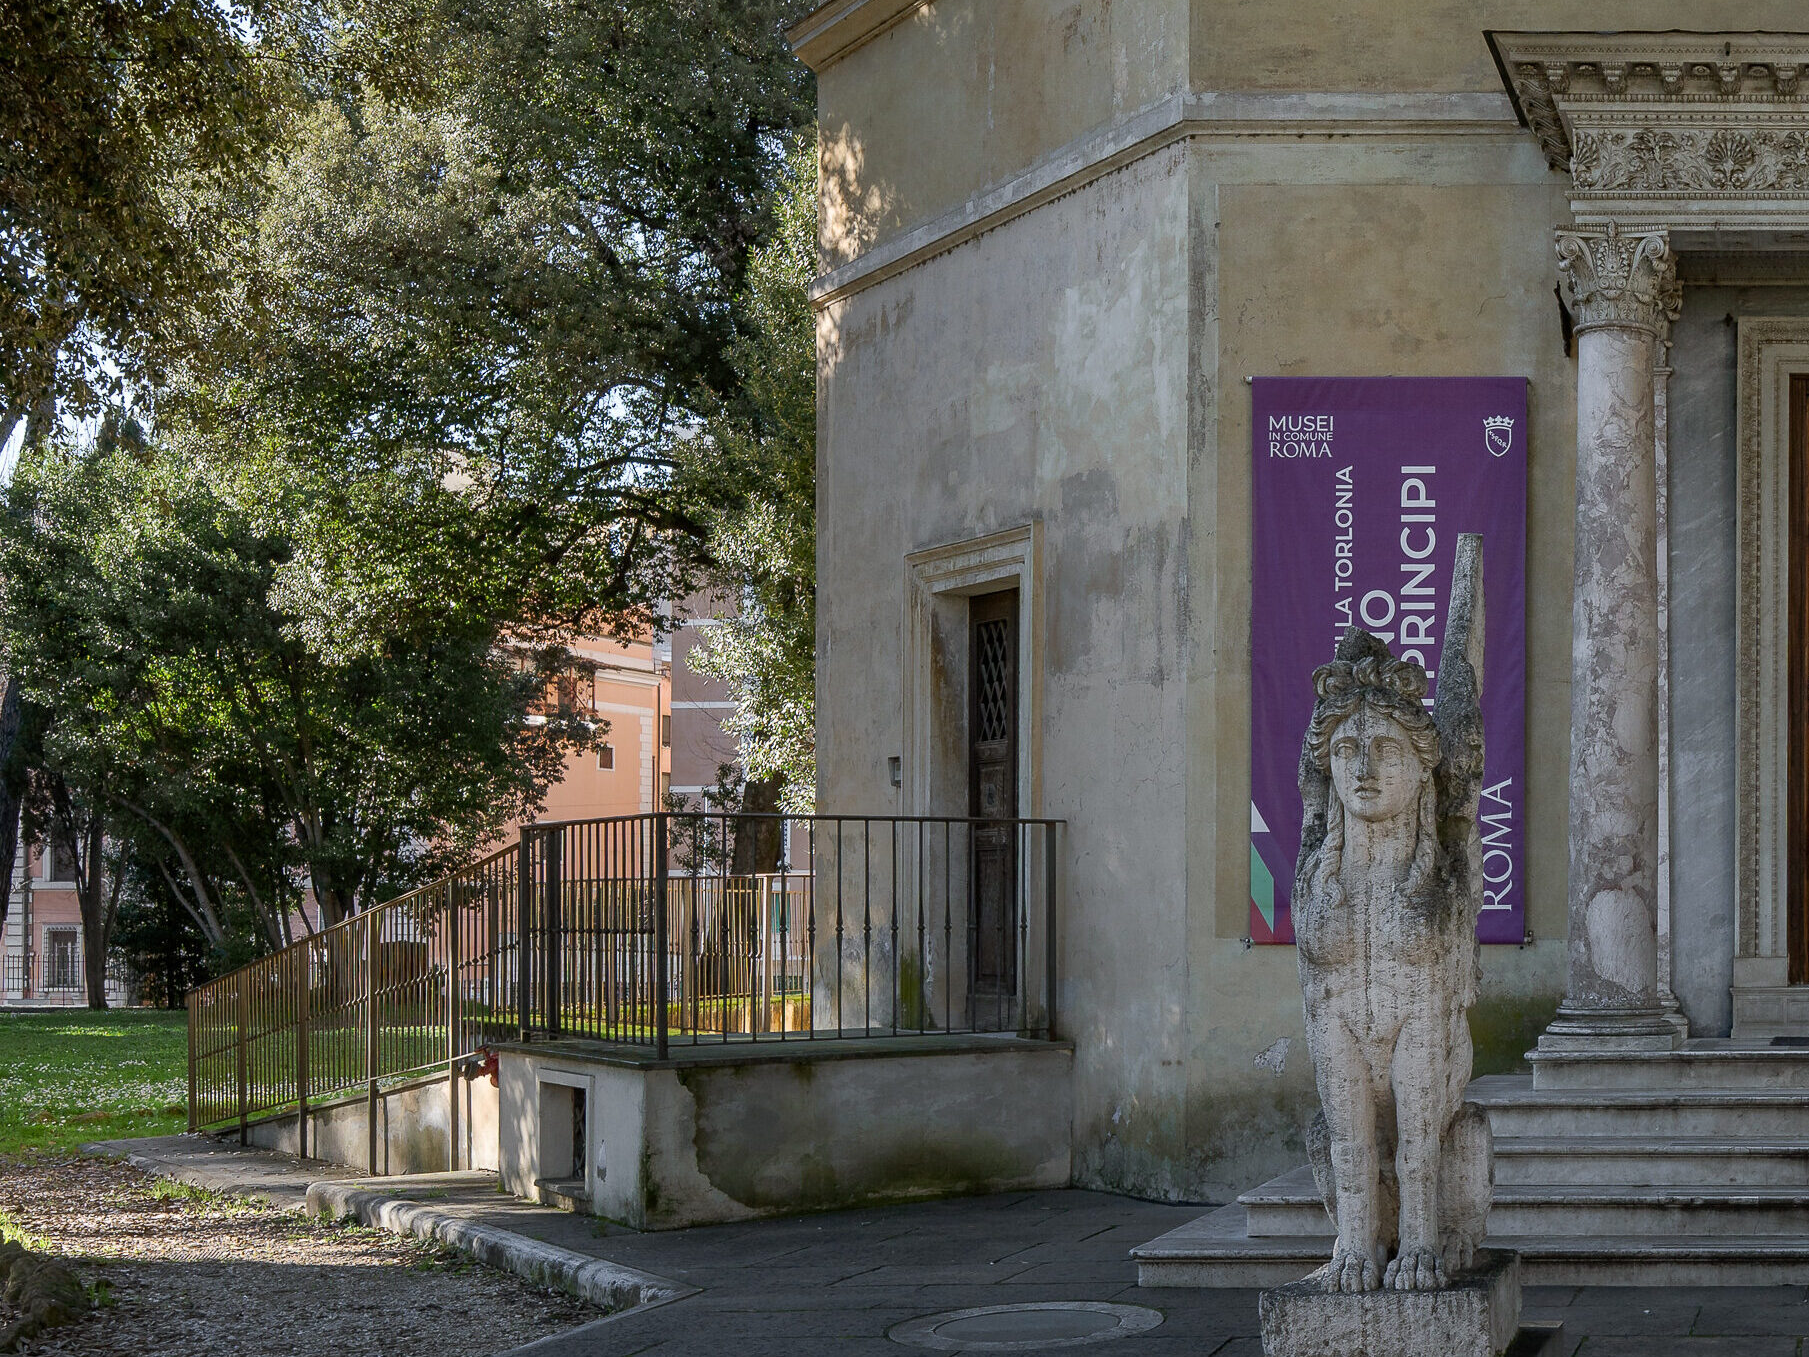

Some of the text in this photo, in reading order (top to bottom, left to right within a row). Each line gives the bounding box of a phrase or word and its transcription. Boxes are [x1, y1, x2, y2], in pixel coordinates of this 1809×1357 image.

[1269, 415, 1334, 431] MUSEI
[1269, 432, 1333, 441] IN COMUNE
[1270, 442, 1332, 458] ROMA
[1335, 465, 1353, 591] TORLONIA
[1480, 777, 1512, 911] ROMA
